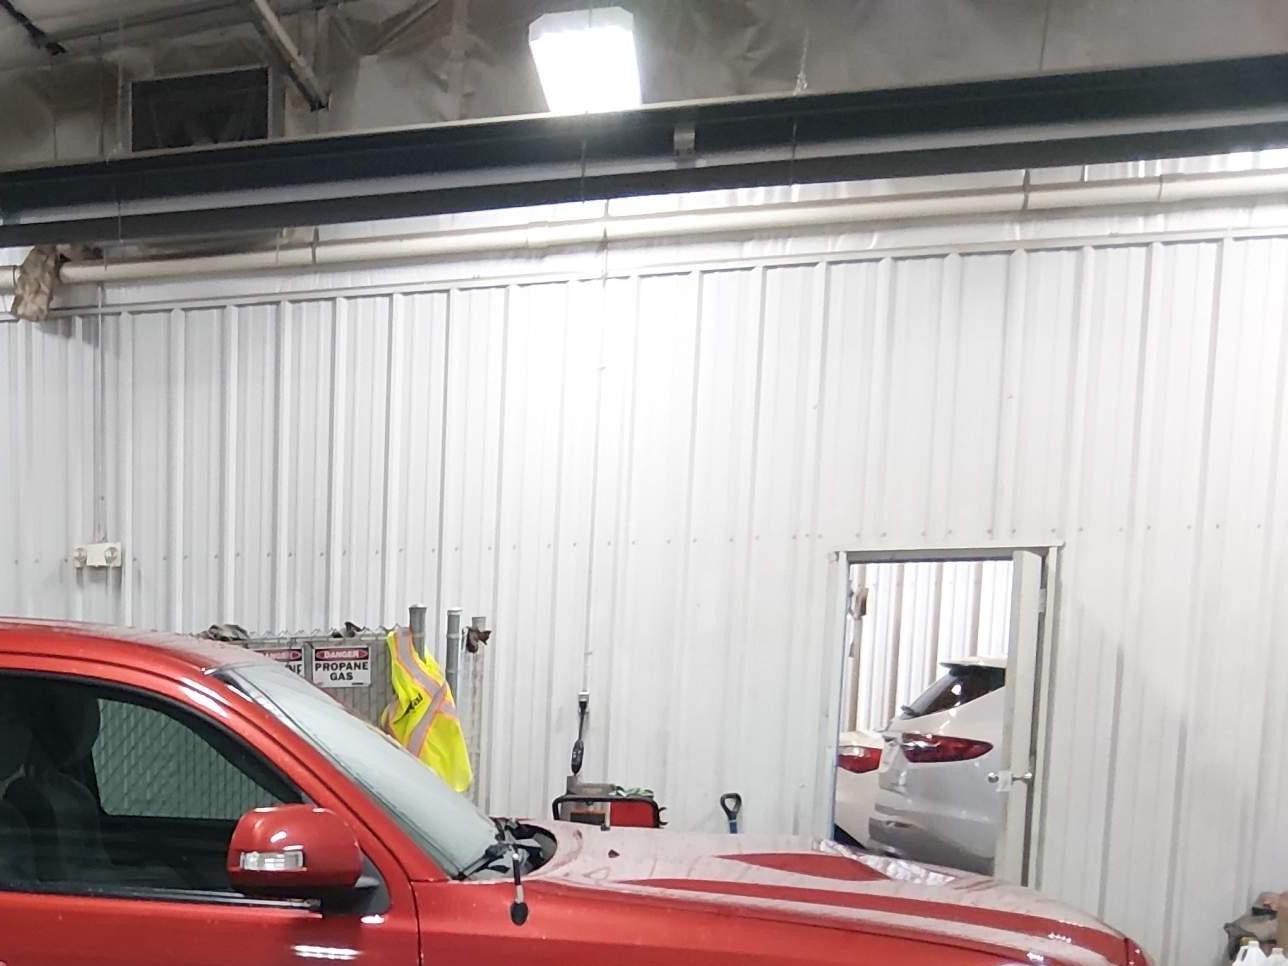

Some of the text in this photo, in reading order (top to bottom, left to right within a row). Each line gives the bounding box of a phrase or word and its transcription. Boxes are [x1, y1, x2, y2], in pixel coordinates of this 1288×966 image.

[323, 649, 360, 659] DANGER
[314, 661, 369, 672] PROPANE
[329, 671, 354, 681] GAS
